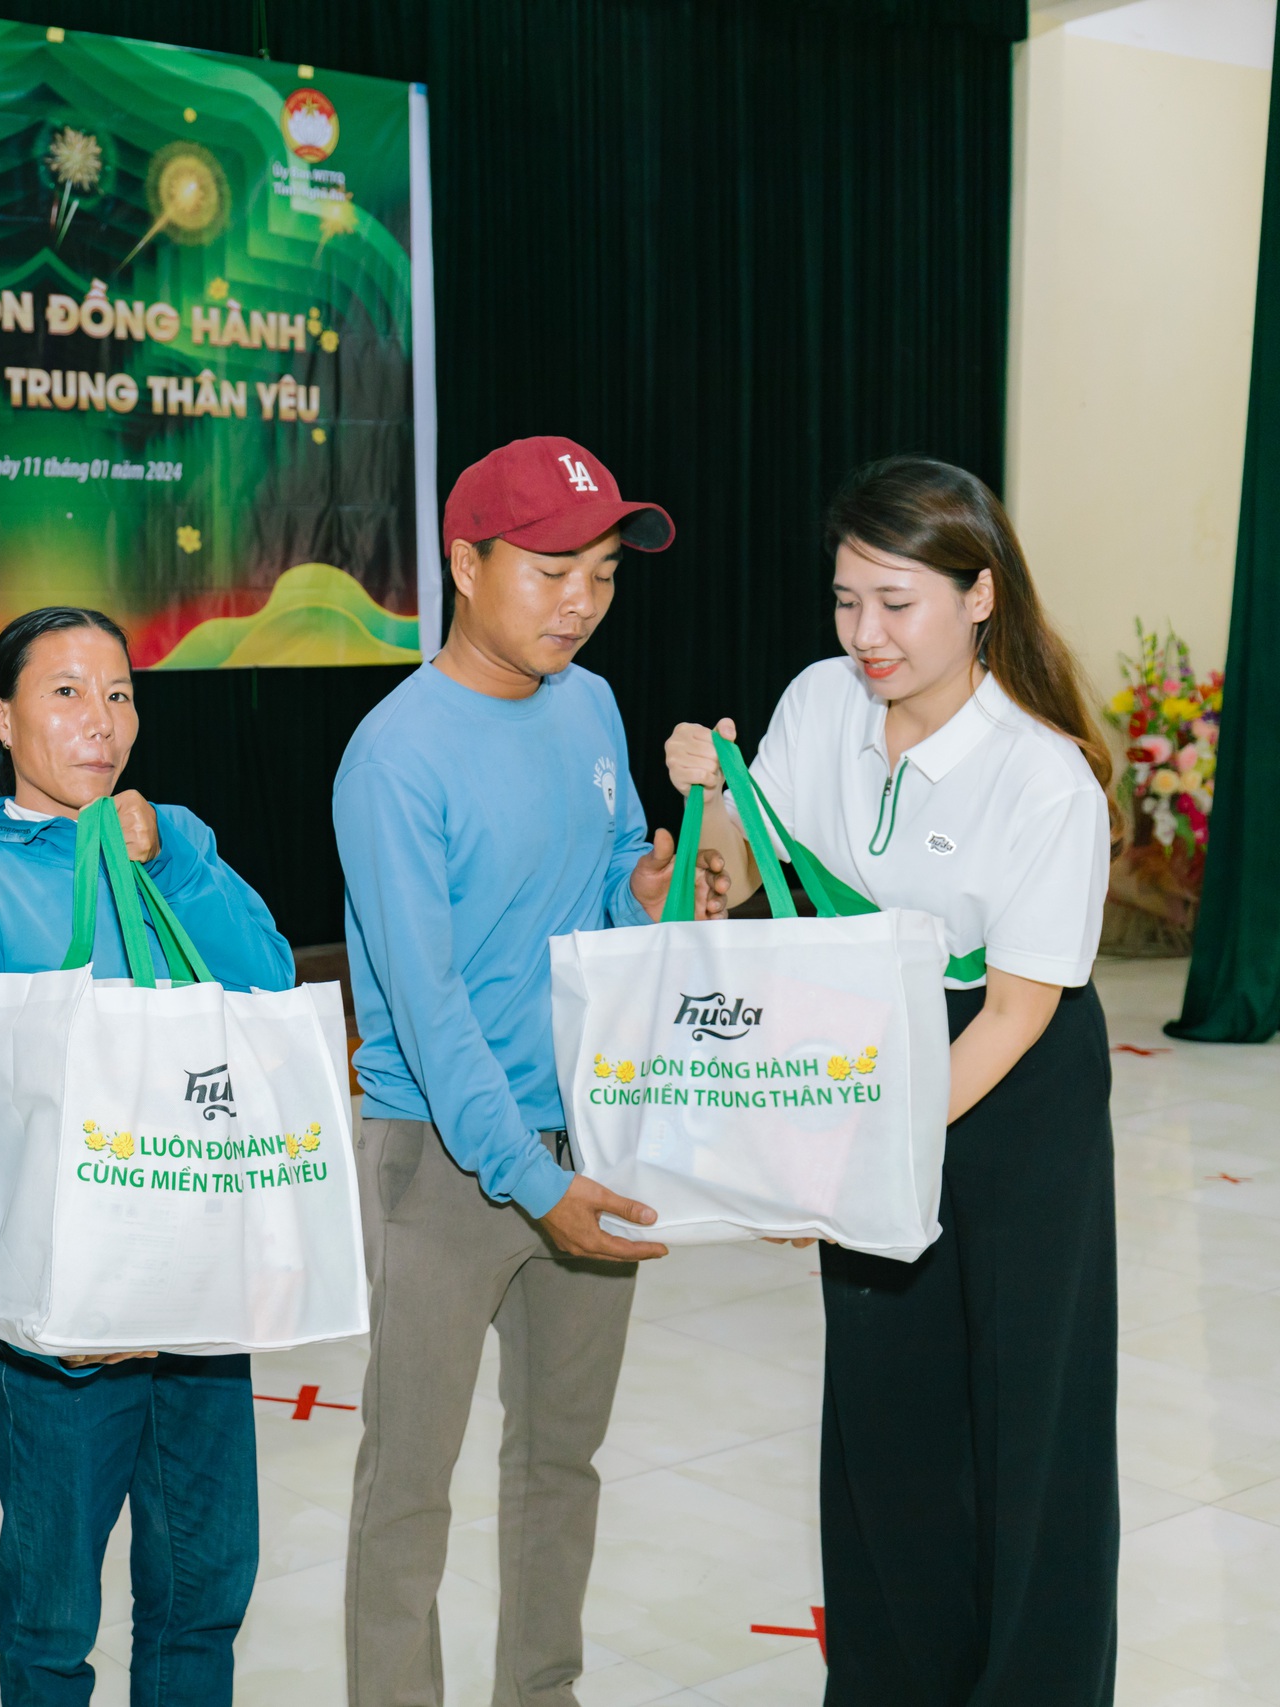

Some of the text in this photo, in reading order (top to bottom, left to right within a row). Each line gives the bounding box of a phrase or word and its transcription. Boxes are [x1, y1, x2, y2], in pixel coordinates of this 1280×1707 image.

[46, 278, 180, 342] ĐỒNG
[192, 298, 306, 352] HÀNH
[4, 366, 138, 413] TRUNG
[147, 369, 247, 419] THÂN
[257, 374, 320, 423] YÊU
[23, 457, 42, 476] 11
[44, 456, 90, 483] tháng
[91, 459, 110, 478] 01
[111, 460, 145, 479] năm
[145, 461, 183, 481] 2024
[558, 454, 598, 491] LA
[673, 992, 763, 1041] huda
[690, 1056, 750, 1079] ĐỒNG
[756, 1057, 819, 1079] HÀNH
[589, 1084, 641, 1105] CÙNG
[694, 1089, 766, 1108] TRUNG
[769, 1085, 831, 1108] THÂN
[838, 1082, 881, 1104] YÊU
[141, 1135, 202, 1160] LUÔN
[77, 1159, 144, 1188] CÙNG
[151, 1166, 207, 1193] MIỀN
[293, 1160, 327, 1184] YÊU
